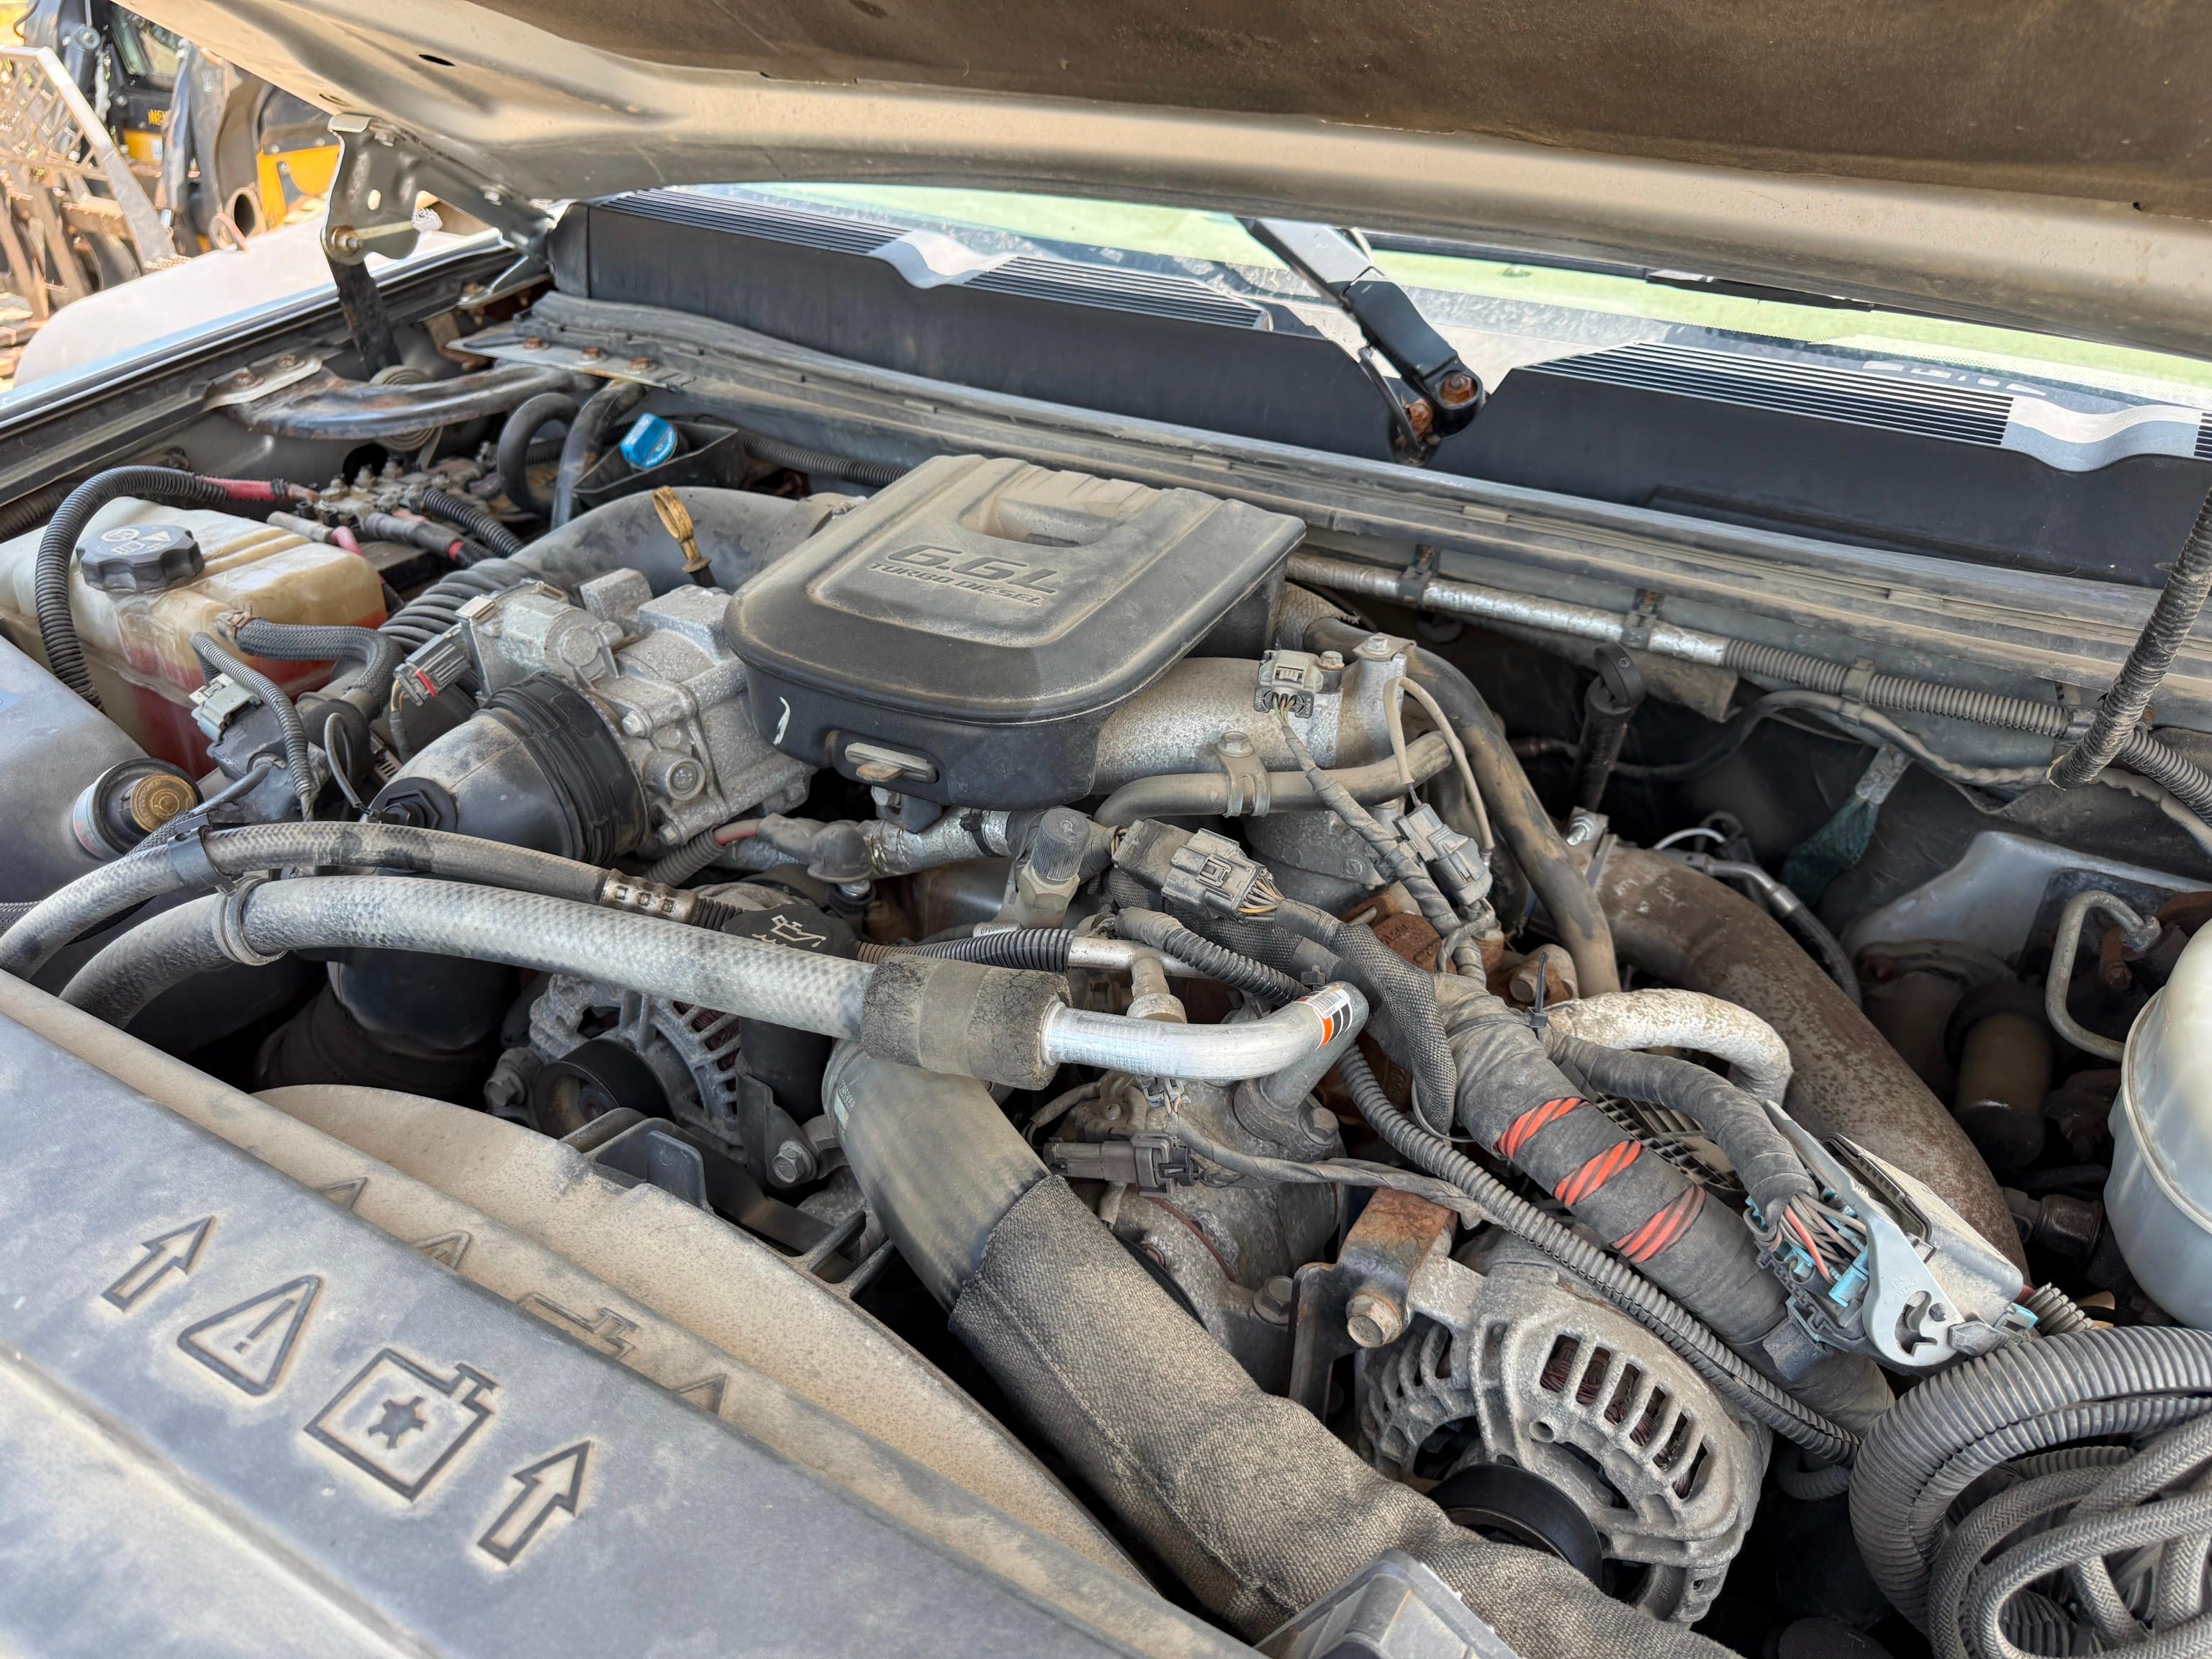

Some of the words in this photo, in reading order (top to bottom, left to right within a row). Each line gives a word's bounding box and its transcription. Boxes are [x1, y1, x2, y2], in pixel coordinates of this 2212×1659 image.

[870, 562, 954, 584] TURBO
[954, 581, 1041, 605] DIESEL
[888, 544, 1058, 594] 6.6L
